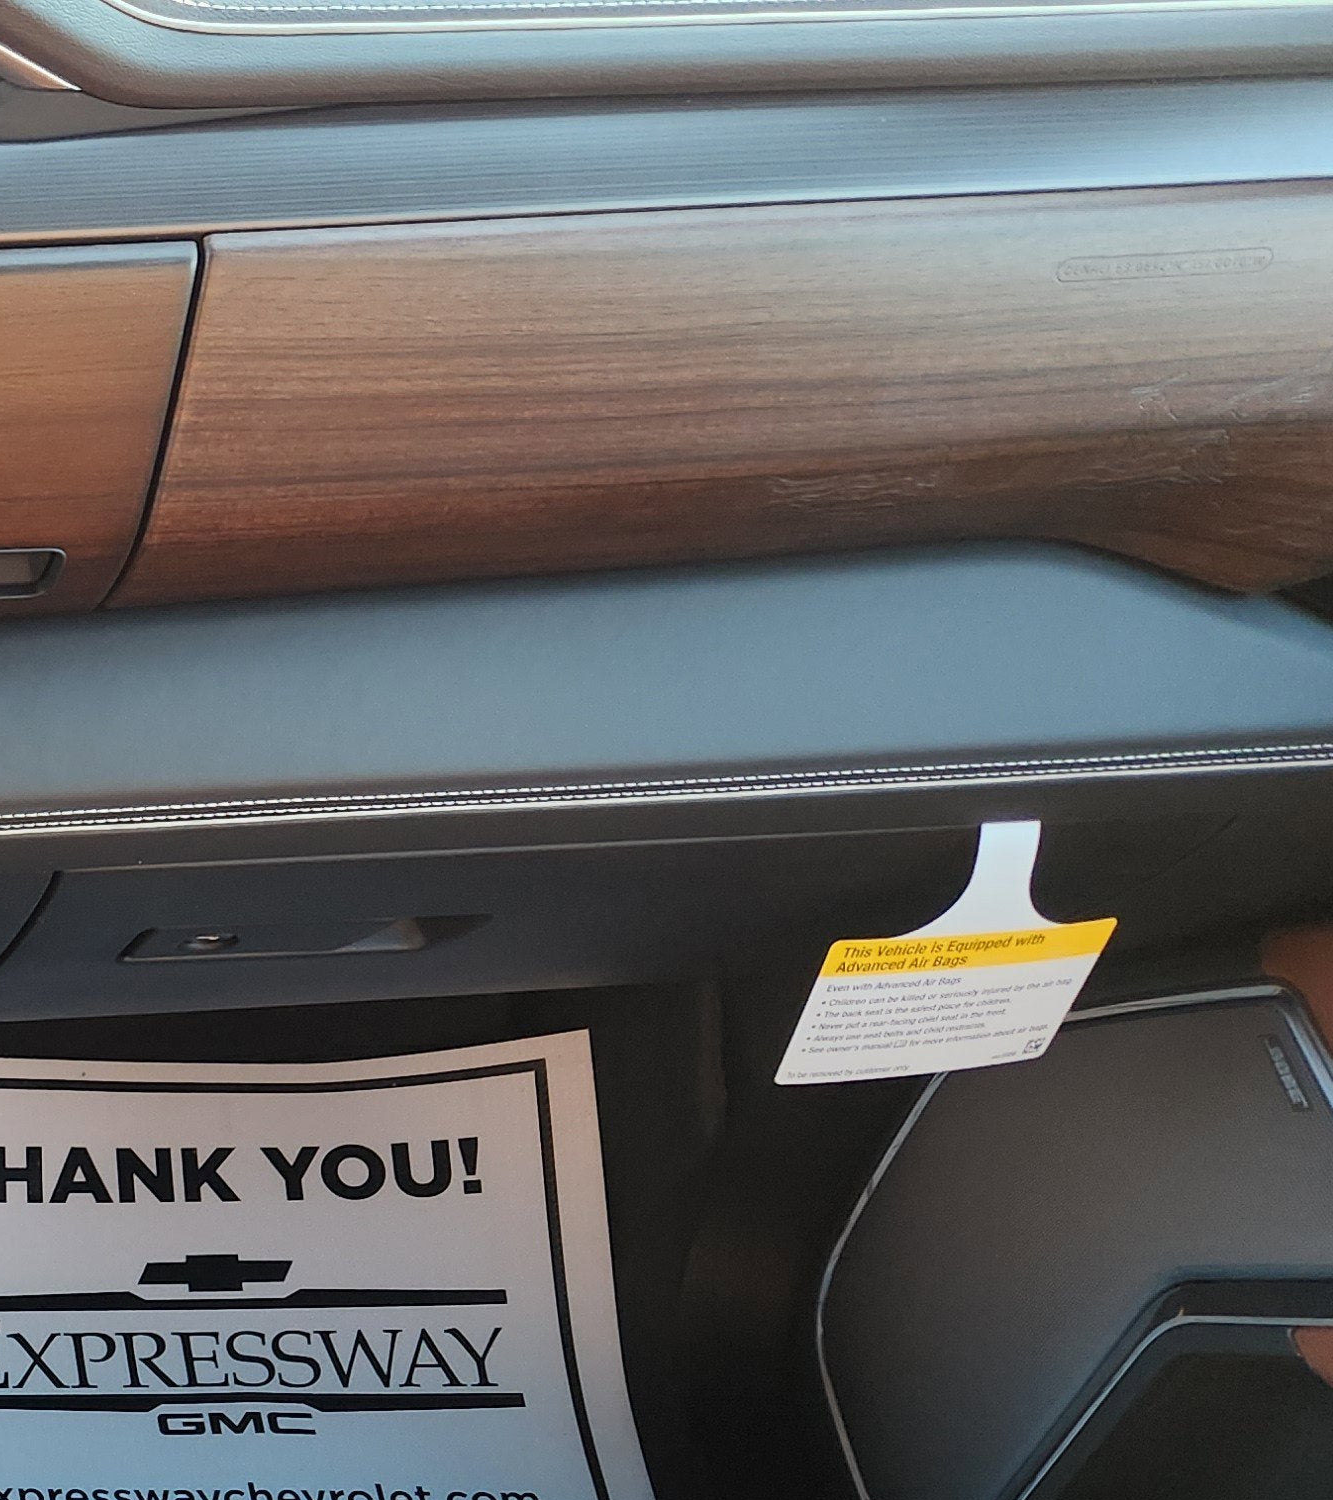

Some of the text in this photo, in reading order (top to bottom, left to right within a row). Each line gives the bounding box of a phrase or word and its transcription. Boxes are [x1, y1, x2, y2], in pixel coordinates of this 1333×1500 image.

[844, 933, 1045, 959] This Vehicle is Equipped with
[836, 955, 969, 973] Advanced Air Bags
[827, 975, 962, 992] Even with Advanced Air Bags
[260, 1136, 483, 1201] YOU!
[157, 1411, 318, 1436] GMC
